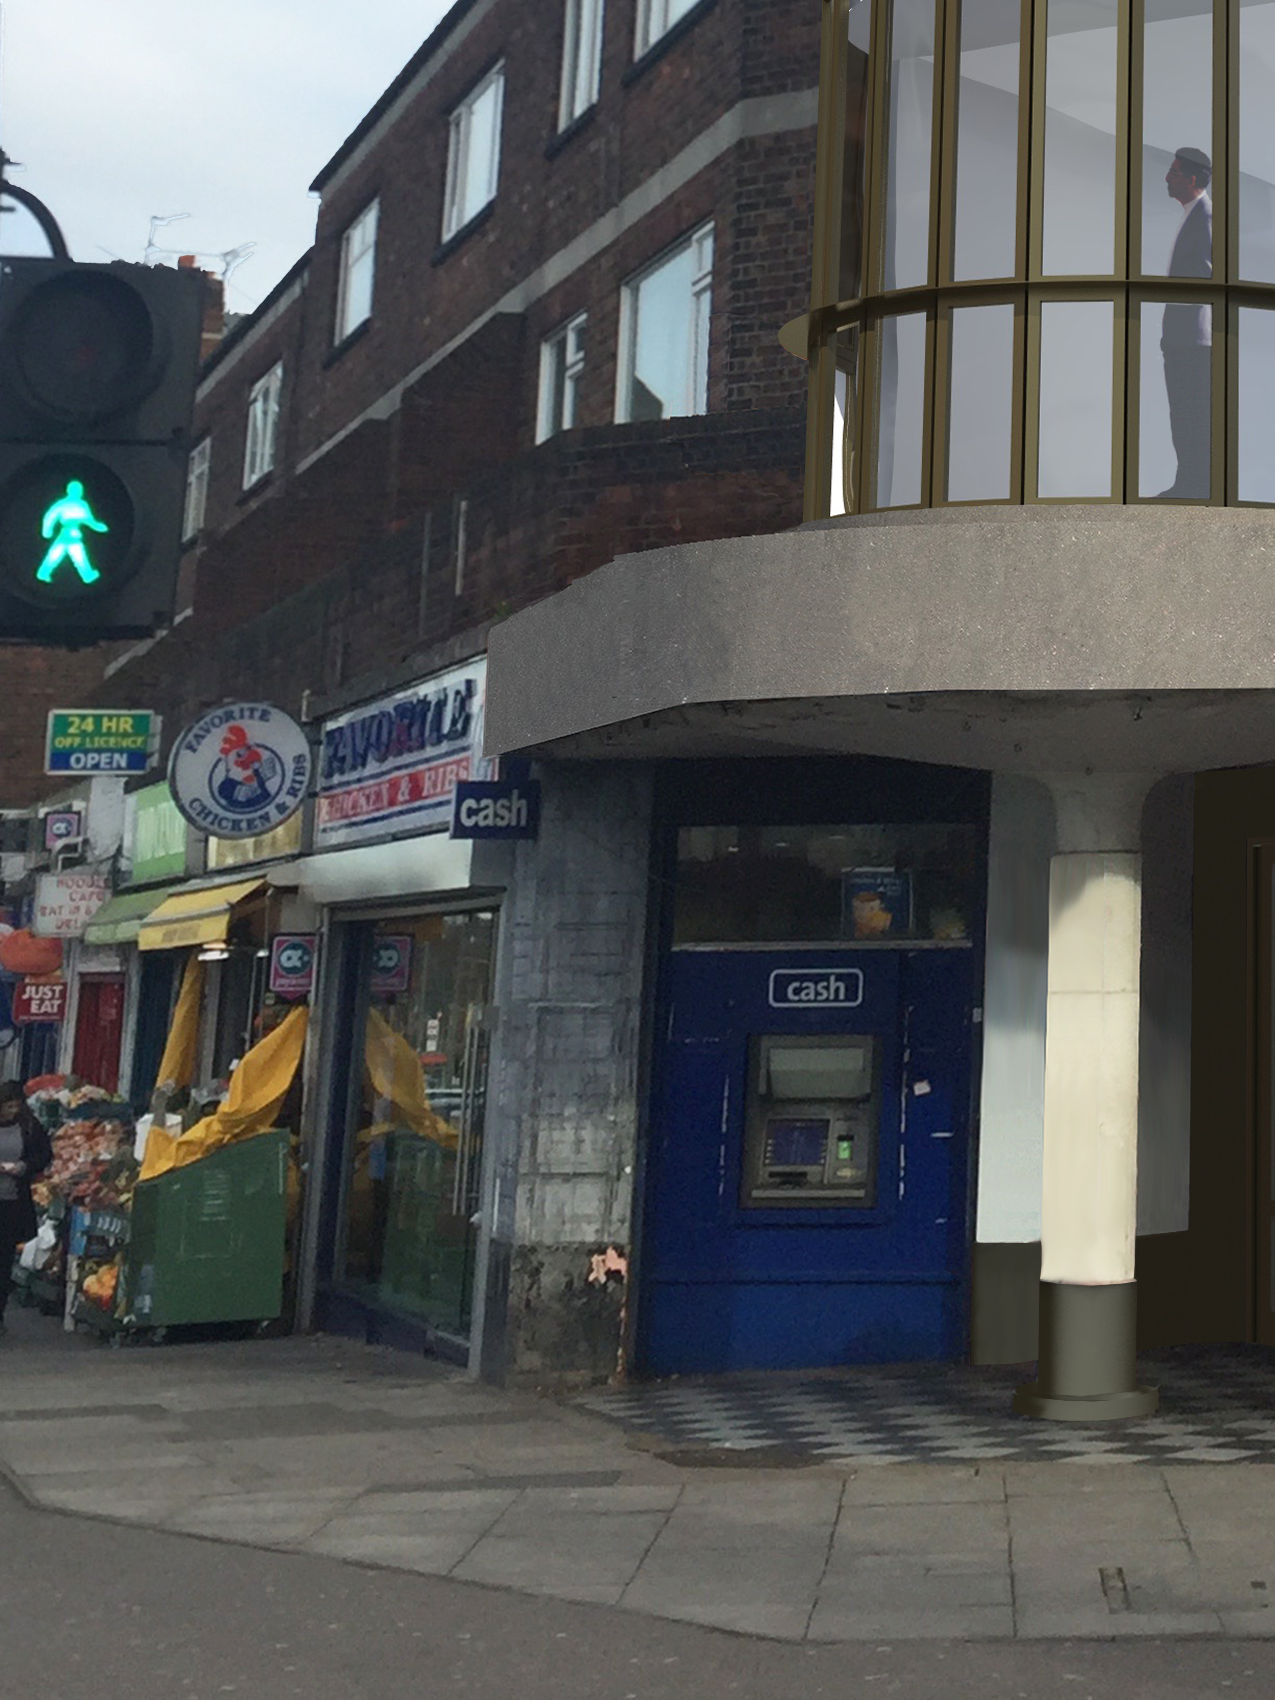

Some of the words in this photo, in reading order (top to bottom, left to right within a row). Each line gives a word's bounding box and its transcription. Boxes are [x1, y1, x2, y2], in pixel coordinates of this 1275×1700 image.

[67, 716, 94, 733] 24
[102, 716, 134, 733] HR
[184, 706, 272, 754] FAVORITE
[54, 736, 82, 748] OFF
[69, 752, 128, 769] OPEN
[188, 797, 271, 832] CHICKEN
[286, 753, 307, 799] RIBS
[318, 782, 391, 822] CHICKEN
[398, 780, 411, 800] &
[423, 757, 472, 798] RIBS
[459, 788, 529, 828] cash
[21, 985, 63, 1000] JUST
[786, 974, 846, 1001] cash
[30, 999, 62, 1015] EAT
